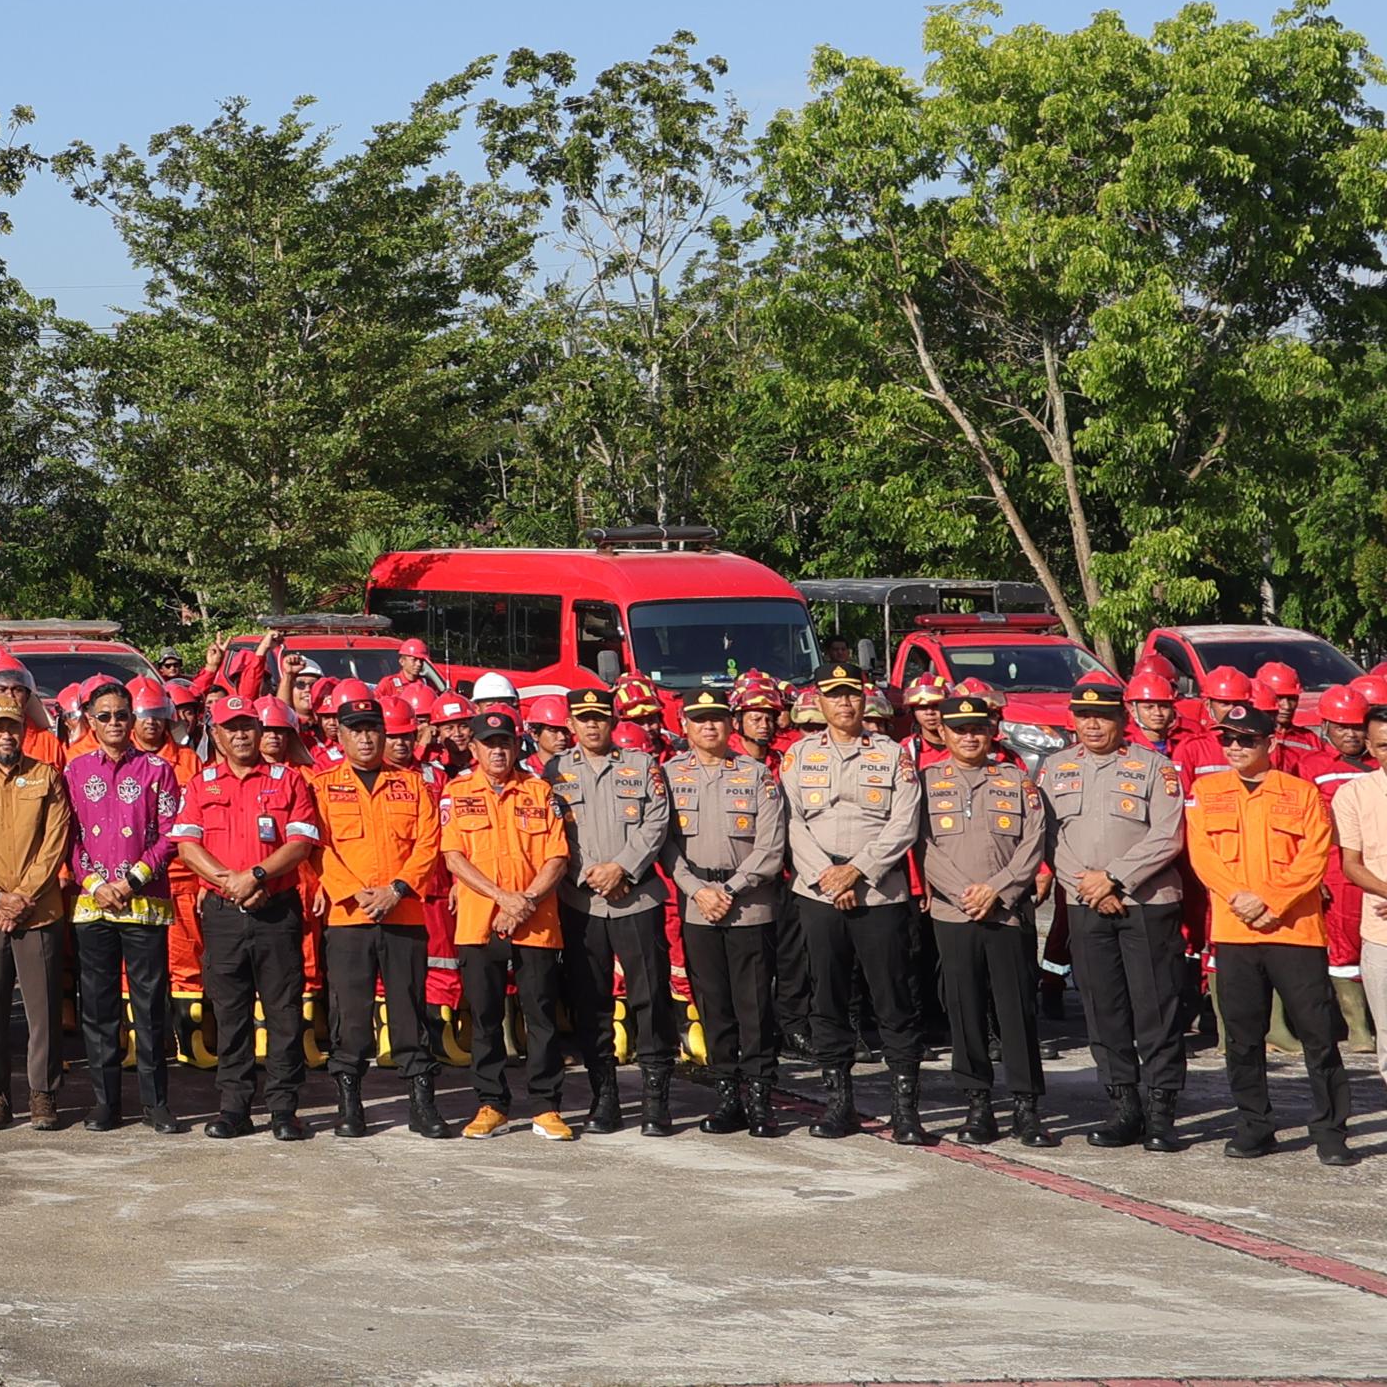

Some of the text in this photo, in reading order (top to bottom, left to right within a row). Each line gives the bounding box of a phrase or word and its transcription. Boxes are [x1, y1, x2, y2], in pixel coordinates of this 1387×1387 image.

[859, 764, 890, 772] POLRI
[1116, 770, 1146, 781] POLRI
[615, 779, 643, 787] POLRI
[726, 788, 755, 796] POLRI
[989, 789, 1019, 798] POLRI
